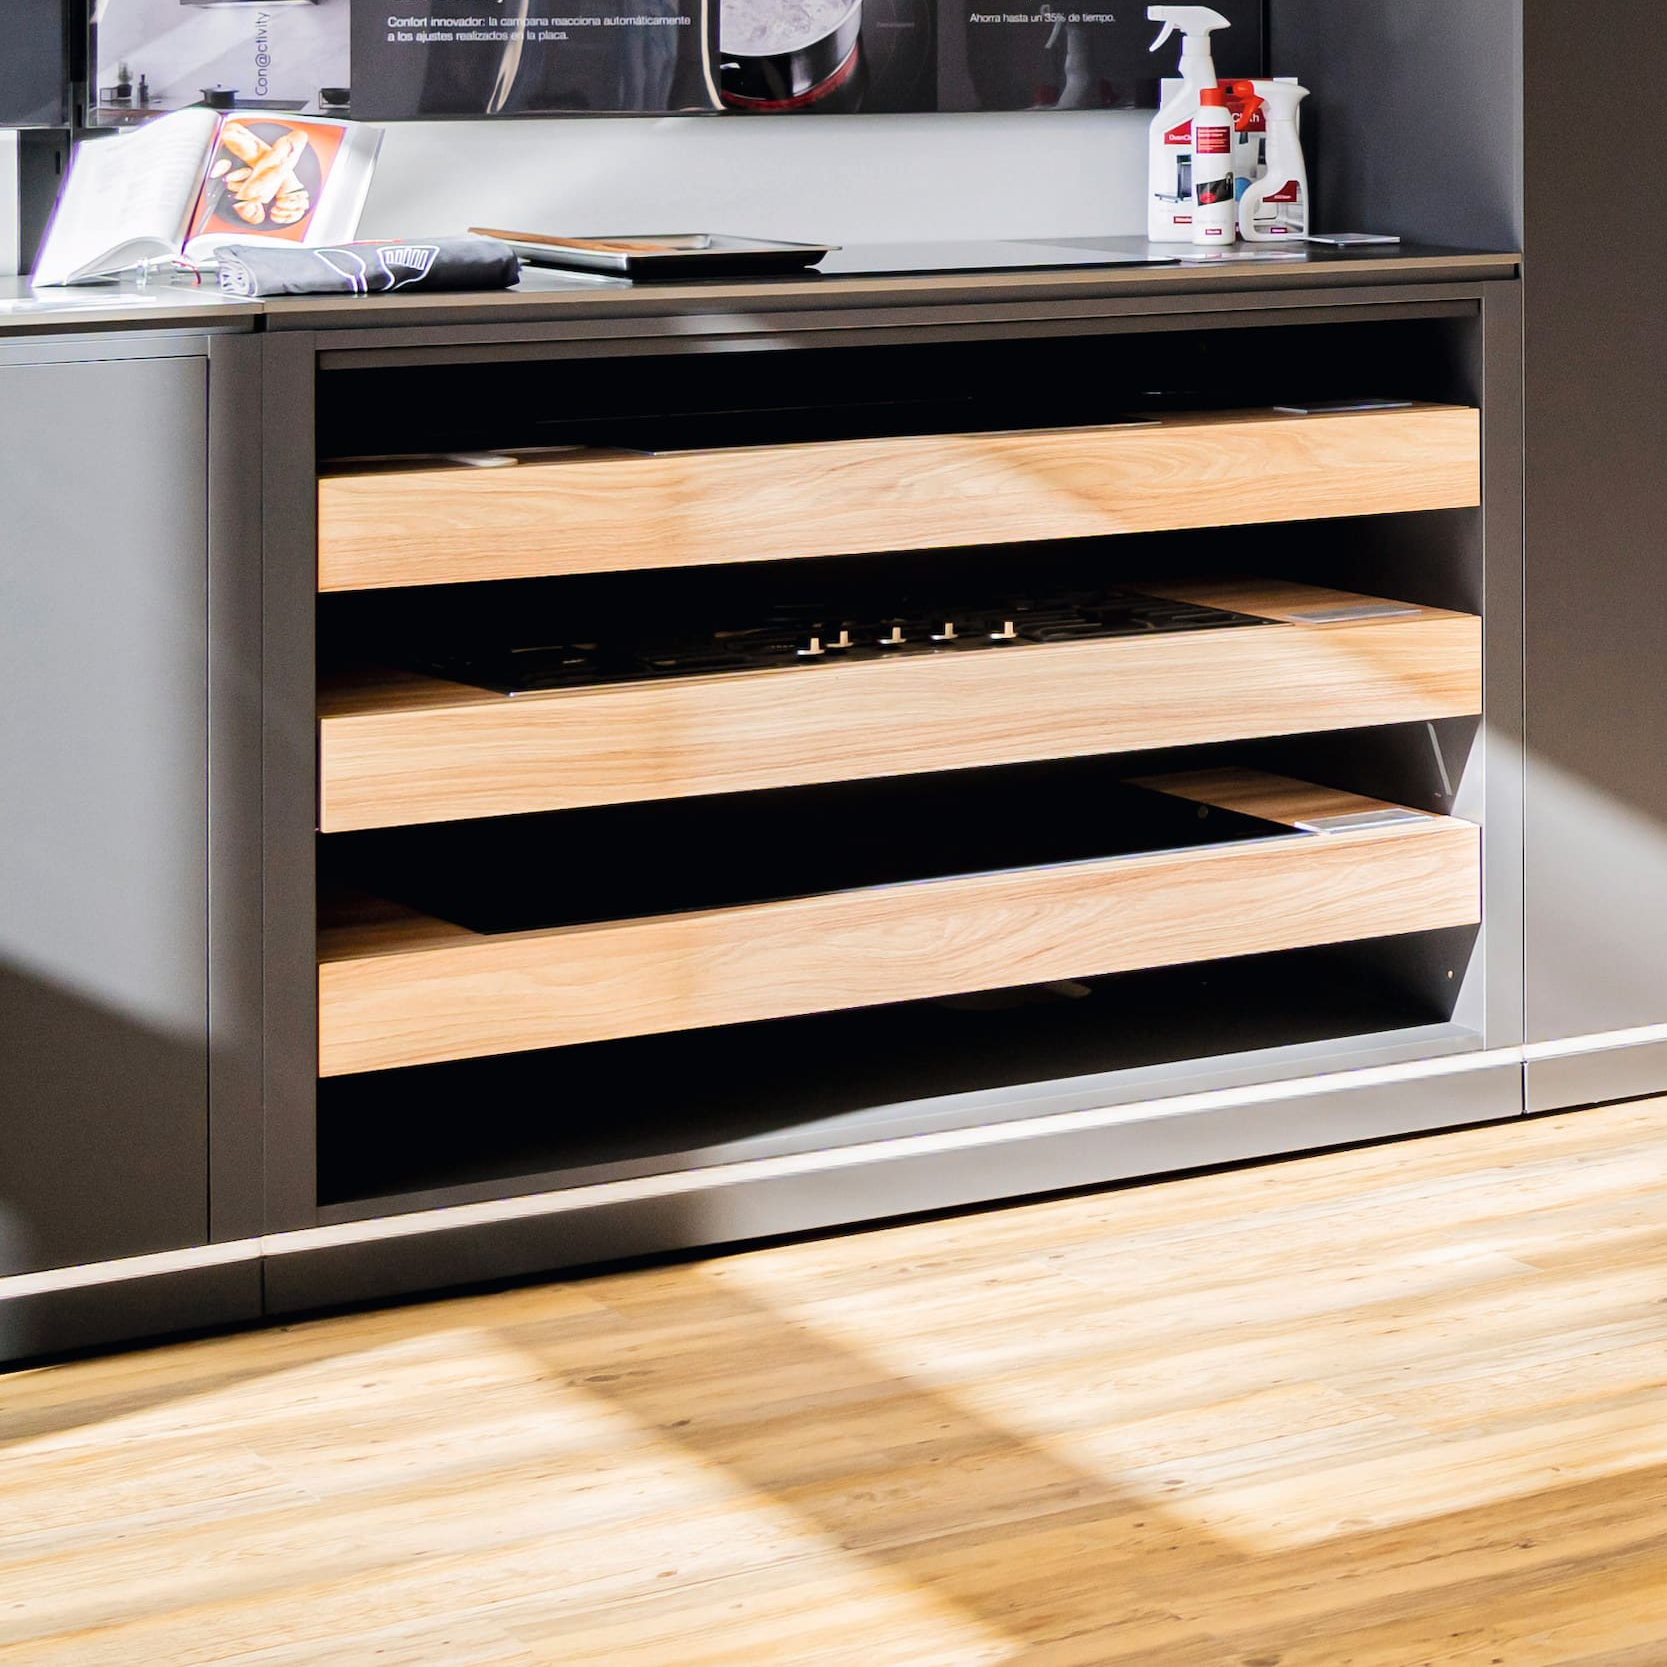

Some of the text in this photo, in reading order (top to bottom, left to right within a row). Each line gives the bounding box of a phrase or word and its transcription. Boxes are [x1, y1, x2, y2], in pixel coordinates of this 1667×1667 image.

[388, 15, 691, 29] Confort innovador: la campana reacciona automáticamente
[970, 13, 1000, 23] Ahorra
[1003, 13, 1028, 23] hasta
[1031, 15, 1042, 23] un
[1069, 13, 1080, 23] de
[1083, 13, 1115, 24] tiempo.
[388, 33, 394, 42] a
[397, 30, 412, 42] los
[416, 30, 453, 43] ajustes
[456, 30, 507, 41] realizados
[527, 30, 535, 40] la
[538, 31, 568, 42] placa.
[255, 12, 271, 96] Con@ctivity
